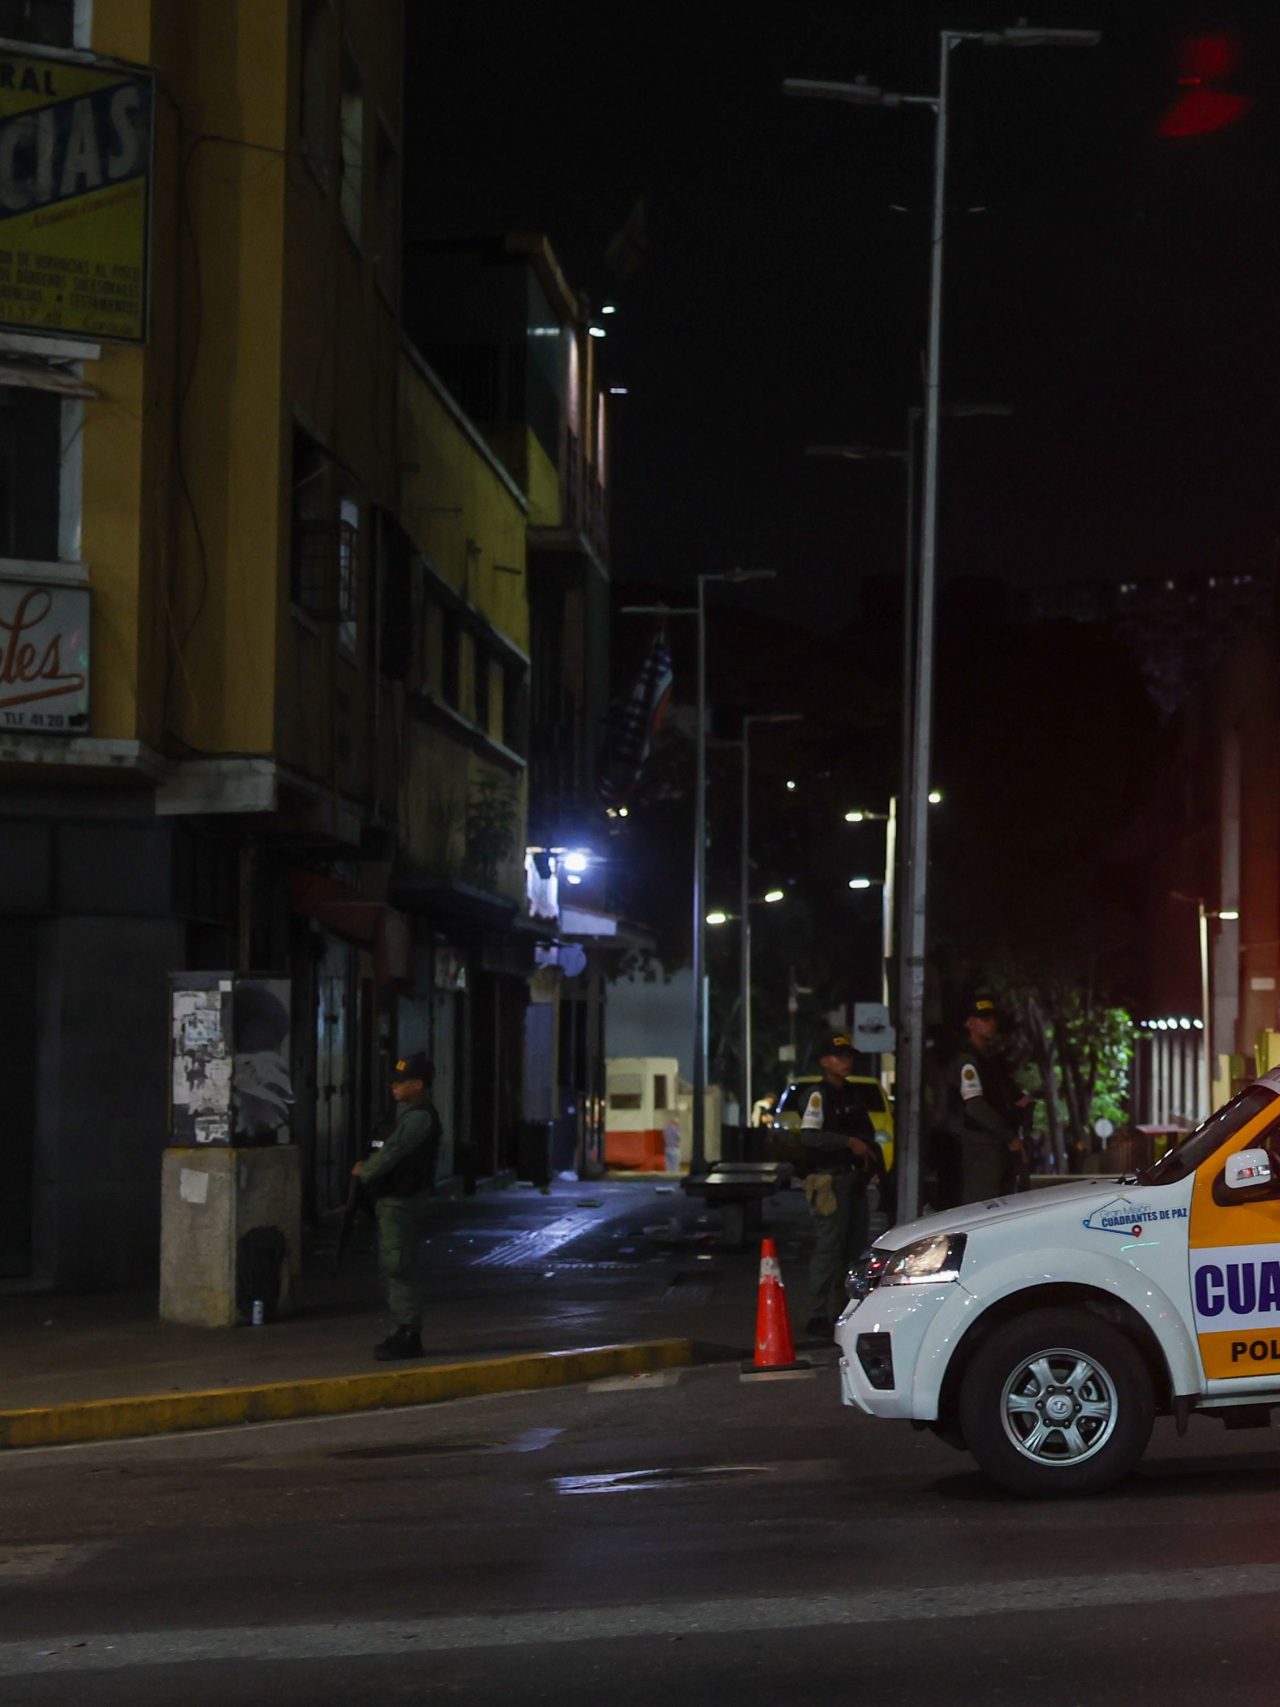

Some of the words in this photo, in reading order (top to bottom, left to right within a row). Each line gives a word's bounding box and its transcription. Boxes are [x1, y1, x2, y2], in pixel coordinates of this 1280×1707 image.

[0, 63, 57, 96] RAL
[0, 85, 141, 210] CIAS
[0, 587, 74, 686] les
[1101, 1212, 1158, 1227] CUADRANTES
[1159, 1210, 1170, 1219] DE
[1171, 1208, 1188, 1218] PAZ
